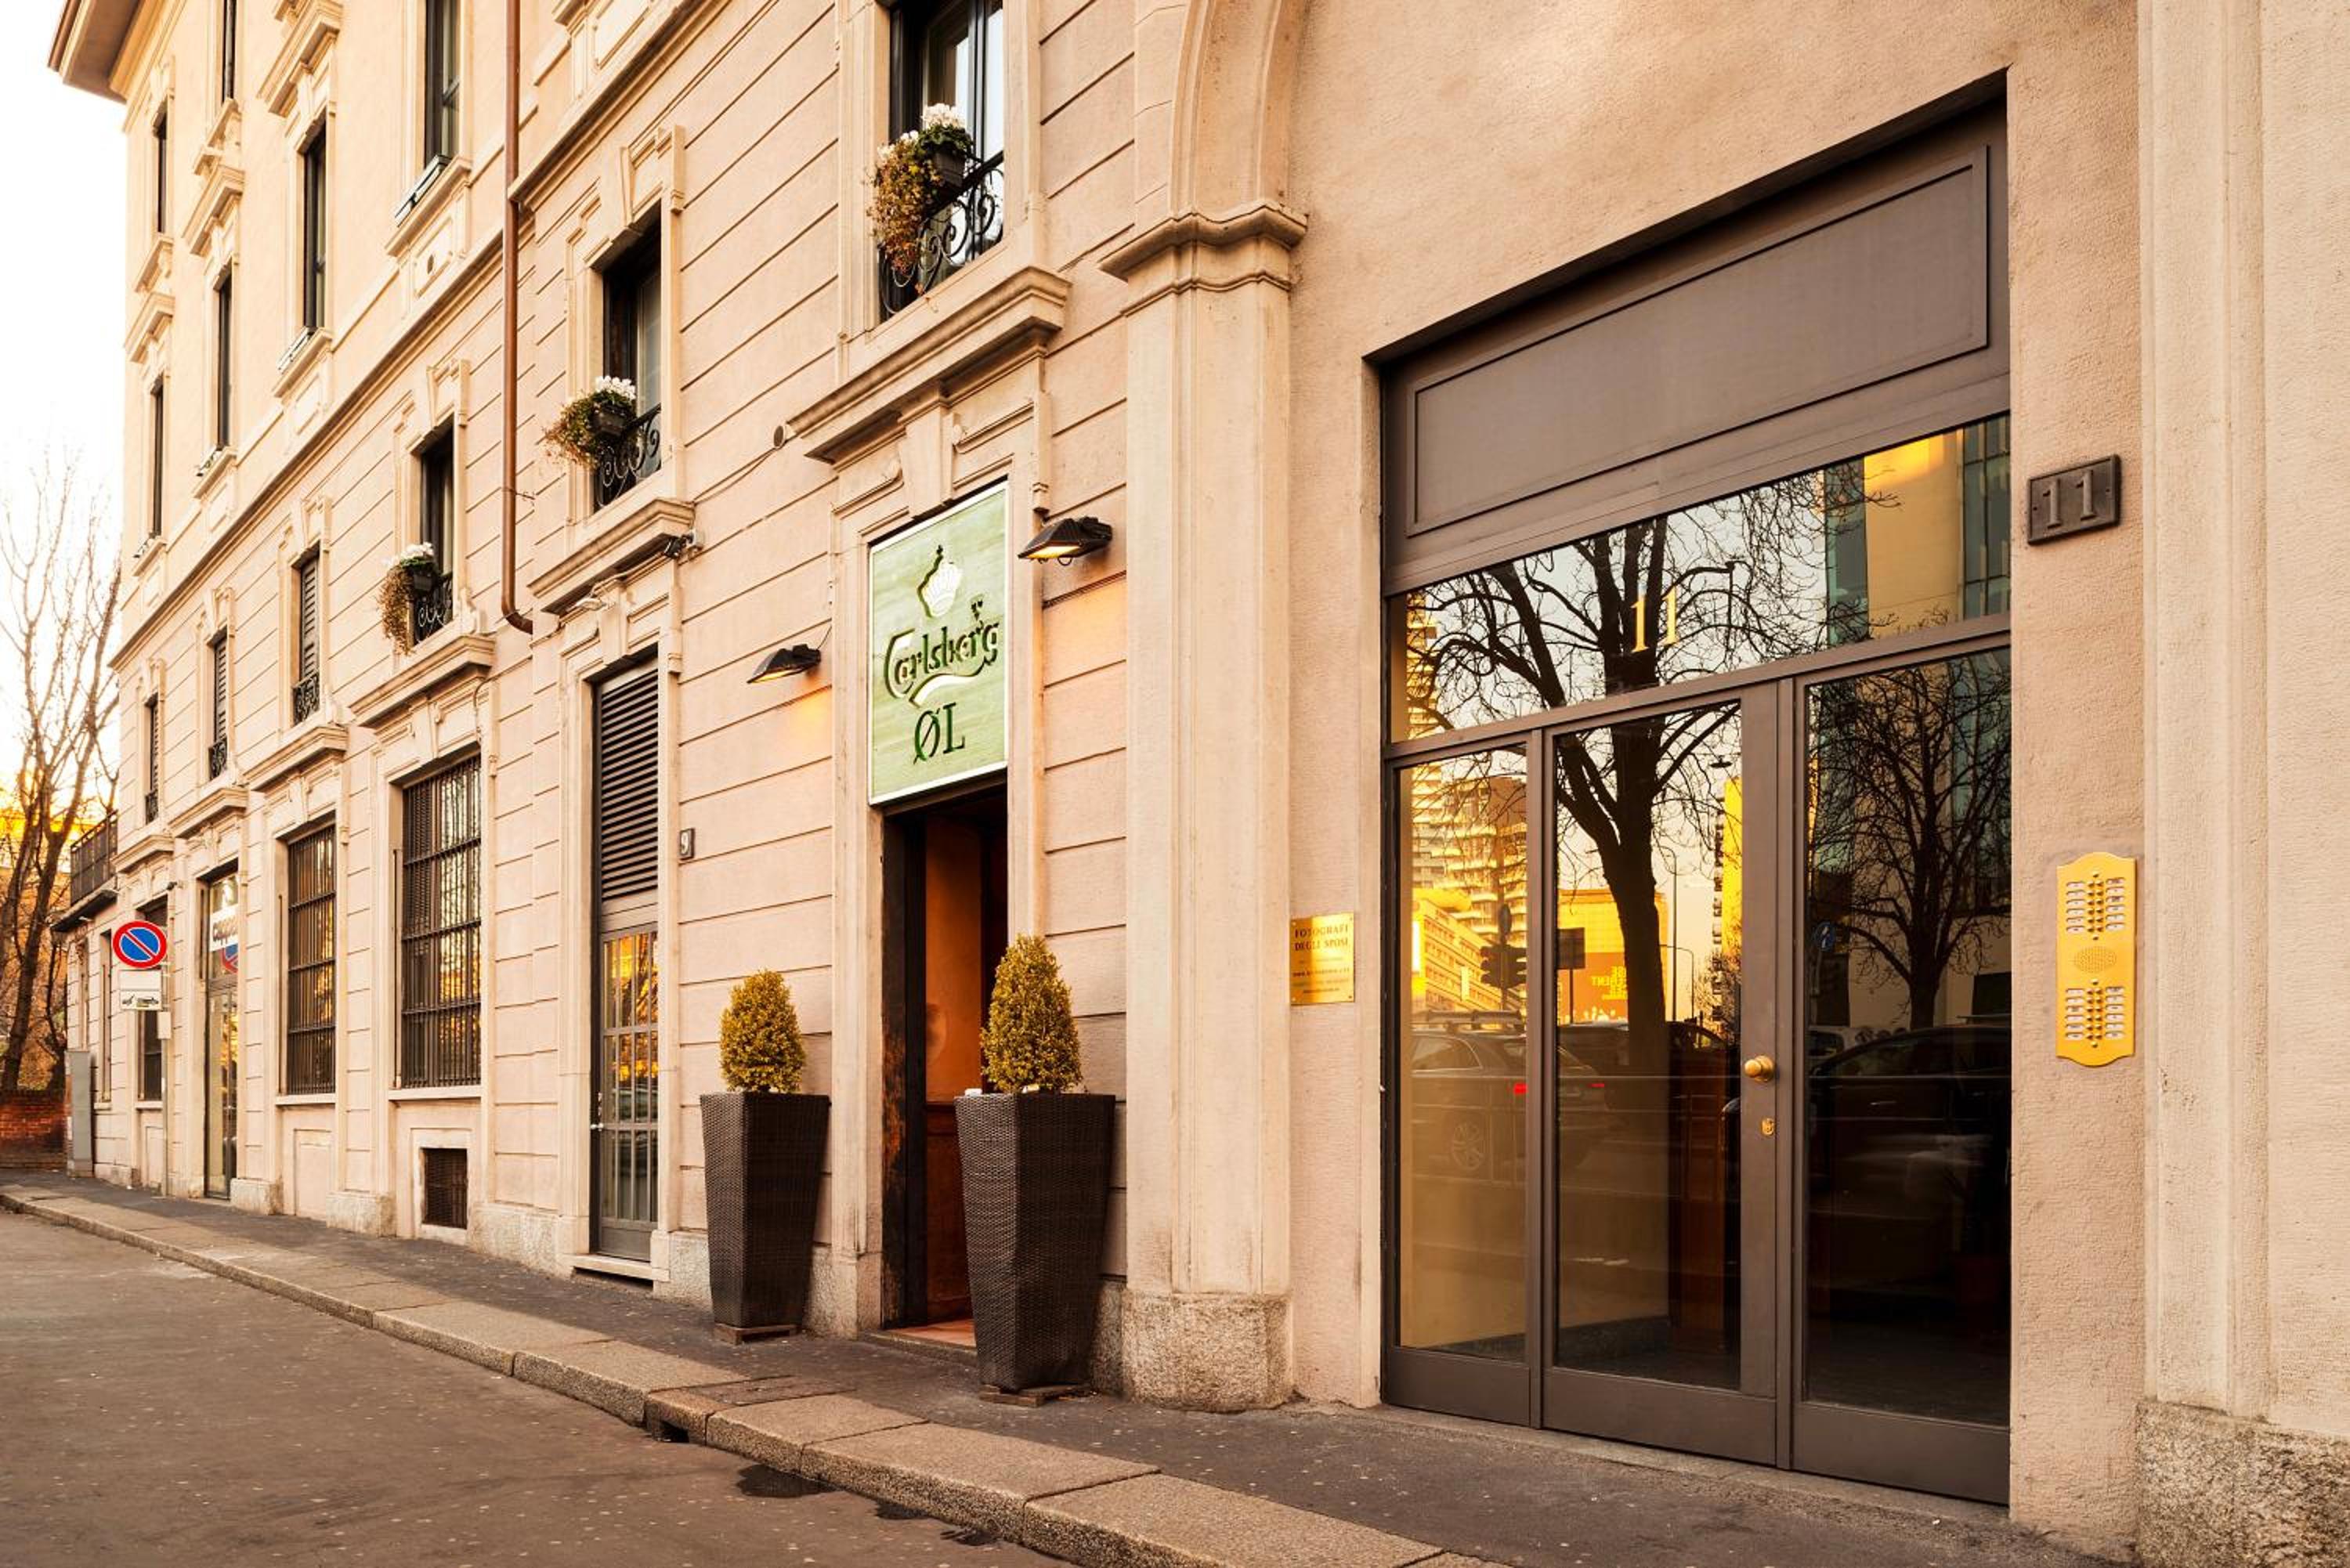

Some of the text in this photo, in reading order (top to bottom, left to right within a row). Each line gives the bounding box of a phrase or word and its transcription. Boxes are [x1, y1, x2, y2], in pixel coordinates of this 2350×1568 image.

[2042, 468, 2098, 529] 11
[1629, 585, 1680, 654] 11
[884, 621, 1000, 699] Carlsberg
[913, 702, 965, 764] ØL
[680, 830, 689, 854] 9
